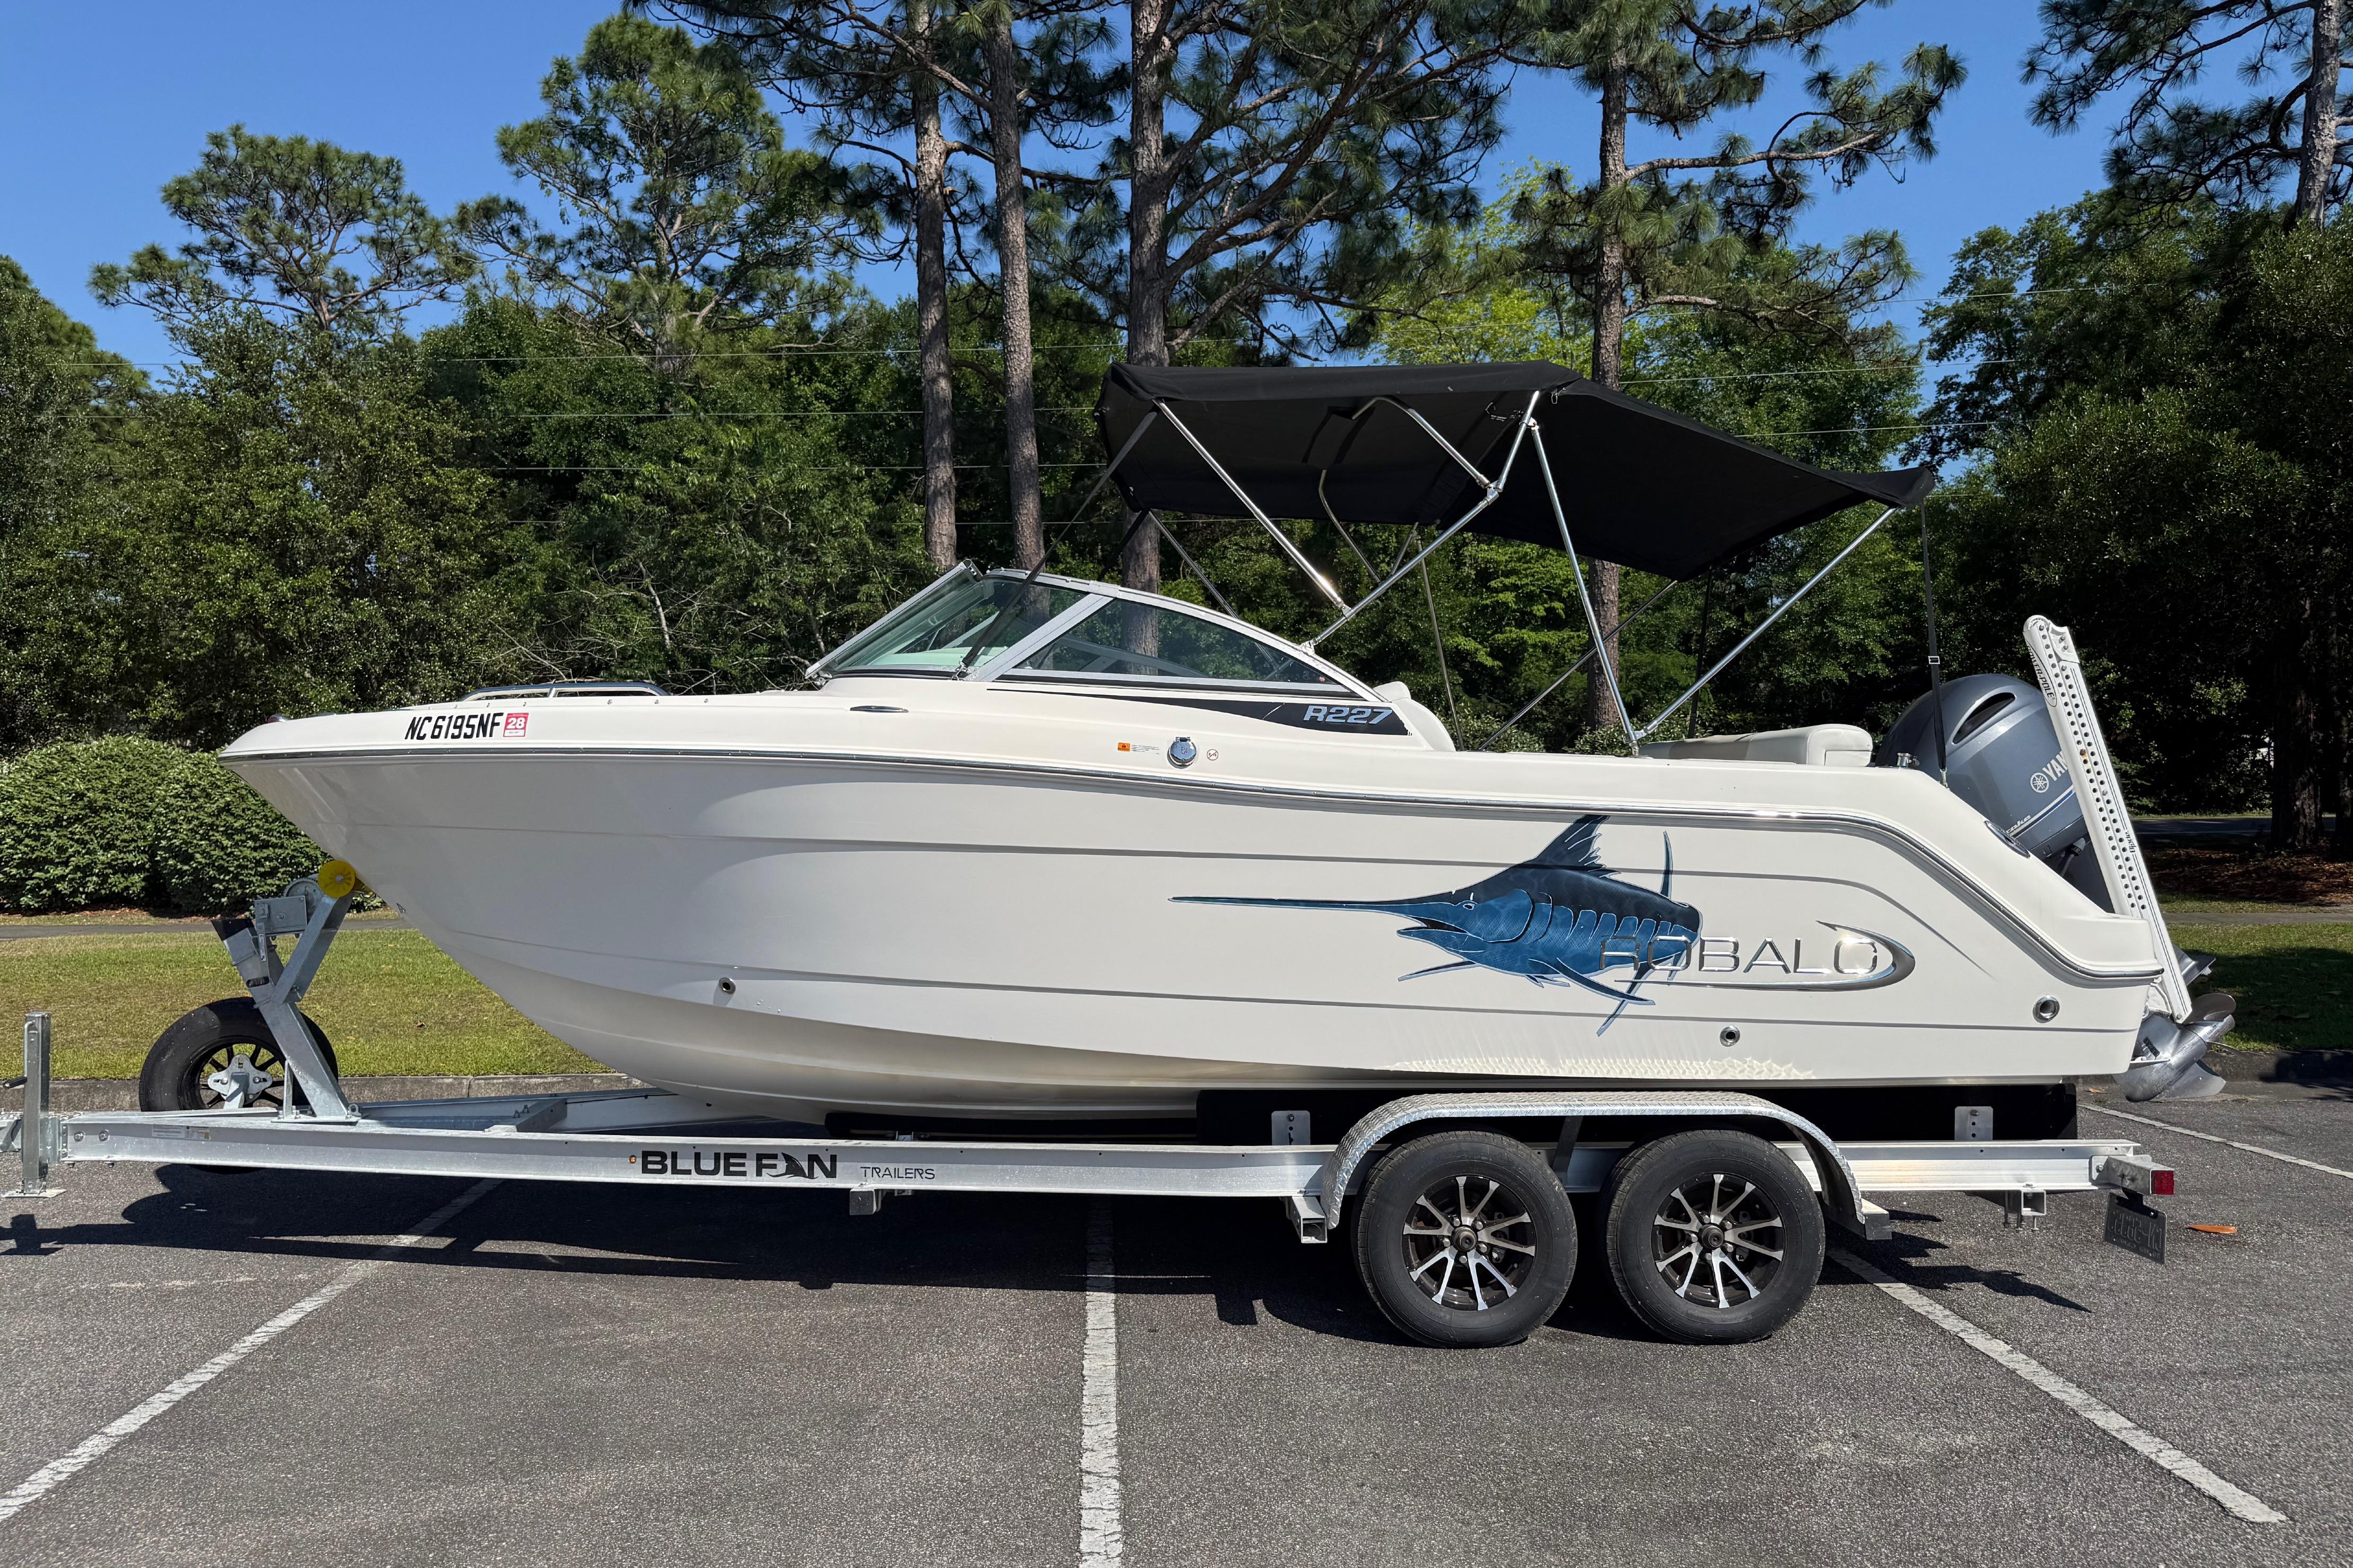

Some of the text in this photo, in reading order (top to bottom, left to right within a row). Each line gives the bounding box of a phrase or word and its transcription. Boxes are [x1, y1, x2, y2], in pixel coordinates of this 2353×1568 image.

[506, 717, 525, 729] 28
[1303, 705, 1393, 724] R227
[2042, 750, 2068, 782] YAM
[1599, 935, 1878, 975] ROBALO
[641, 1150, 747, 1176] BLUE
[860, 1167, 935, 1180] TRAILERS
